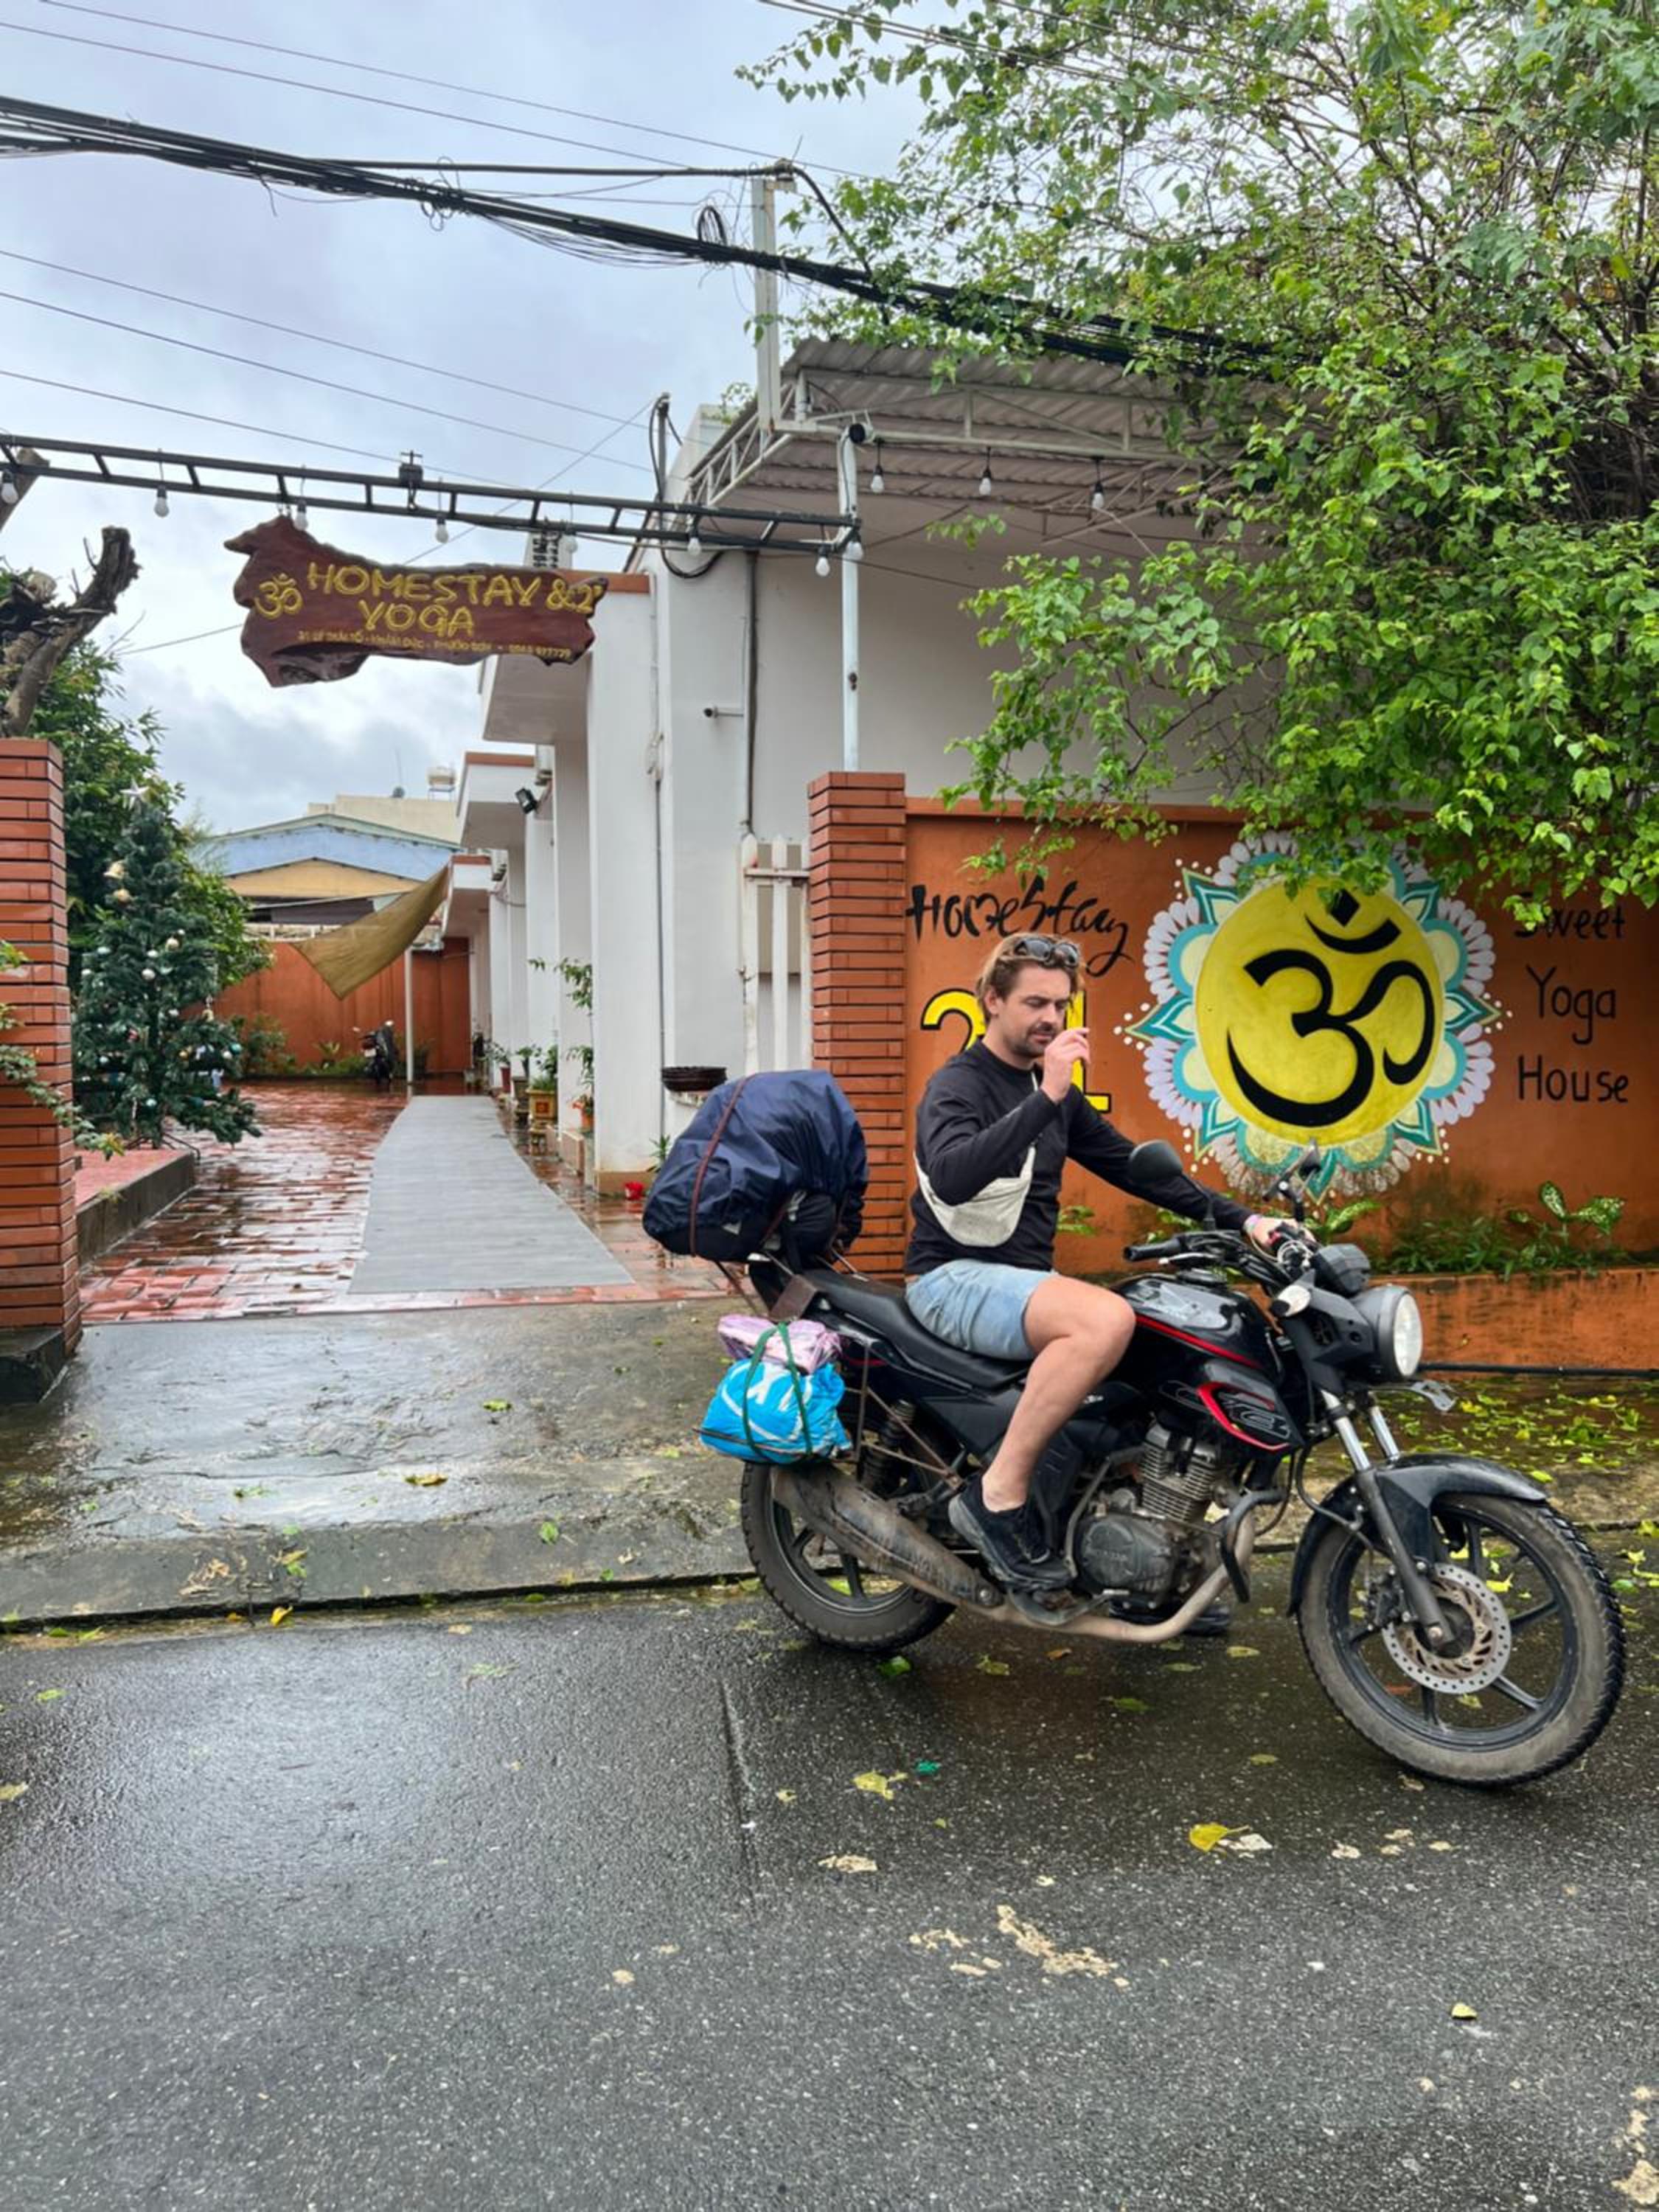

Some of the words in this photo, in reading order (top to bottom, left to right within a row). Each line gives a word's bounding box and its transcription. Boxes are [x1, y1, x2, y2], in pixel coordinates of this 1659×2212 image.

[307, 562, 541, 606] HOMESTAY
[358, 599, 474, 637] YOGA
[1526, 965, 1616, 1044] Yoga
[1517, 1054, 1629, 1102] House
